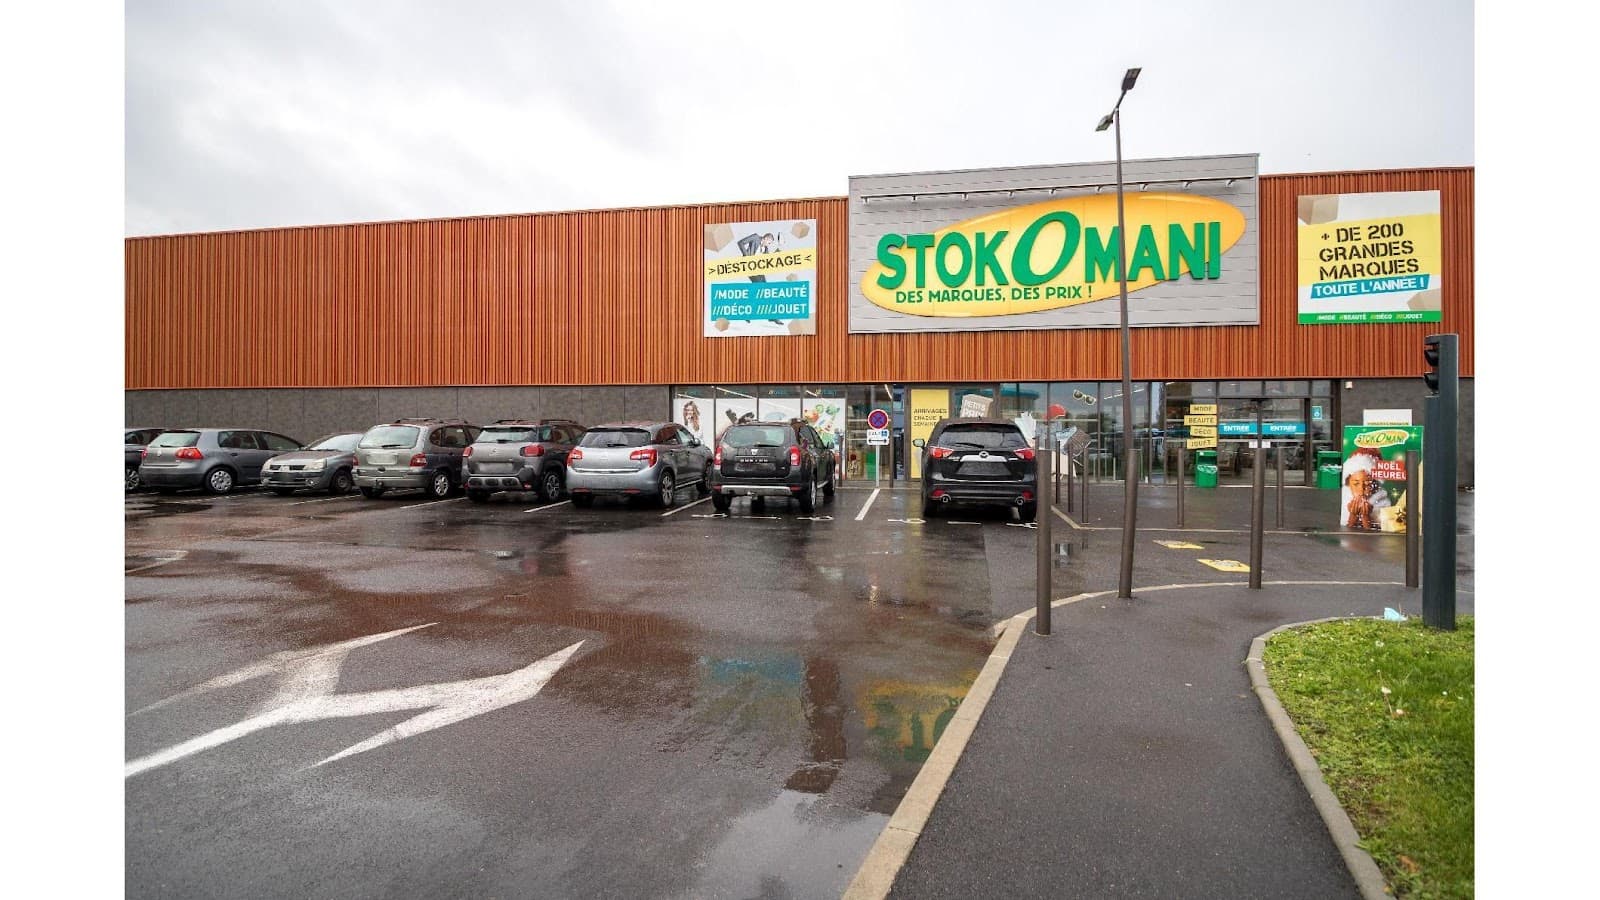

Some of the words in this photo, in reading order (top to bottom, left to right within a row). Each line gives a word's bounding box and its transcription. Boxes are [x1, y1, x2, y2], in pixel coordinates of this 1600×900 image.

[1336, 227, 1362, 243] DE
[1367, 223, 1404, 240] 200
[876, 210, 1222, 289] STOKOMANI
[1319, 240, 1414, 263] GRANDES
[1319, 258, 1420, 281] MARQUES
[895, 290, 923, 305] DES
[928, 287, 1007, 304] MARQUES,
[1011, 286, 1040, 301] DES
[1045, 285, 1082, 299] PRIX
[1087, 284, 1093, 299] !
[1315, 282, 1358, 297] TOUTE
[1360, 277, 1417, 294] L'ANNÉE
[1419, 277, 1425, 288] !
[1371, 470, 1407, 480] HEUREU
[1377, 461, 1401, 471] NOËL
